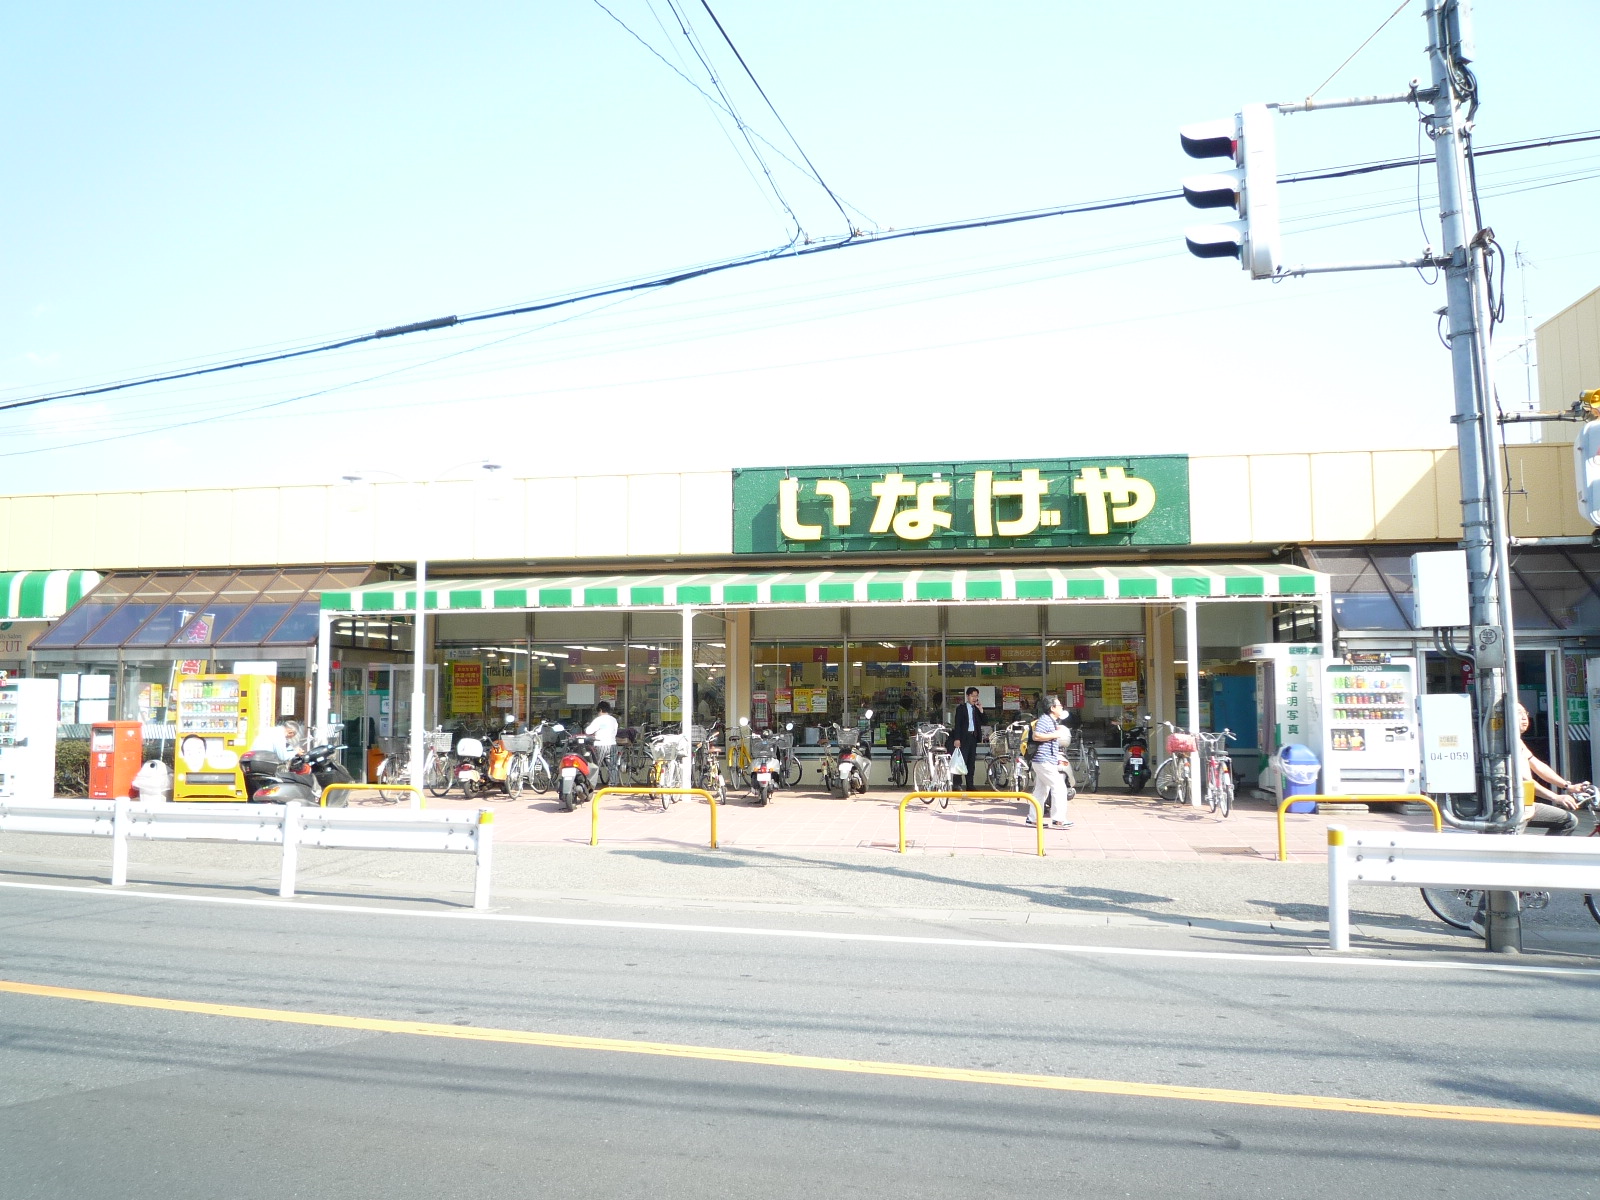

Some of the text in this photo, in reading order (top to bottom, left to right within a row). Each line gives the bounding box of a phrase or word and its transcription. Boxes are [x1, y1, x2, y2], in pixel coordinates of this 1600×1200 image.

[779, 466, 1156, 541] いなげや
[1351, 664, 1383, 672] inageya
[1286, 682, 1299, 735] 証明写真
[1430, 751, 1469, 760] 04-059
